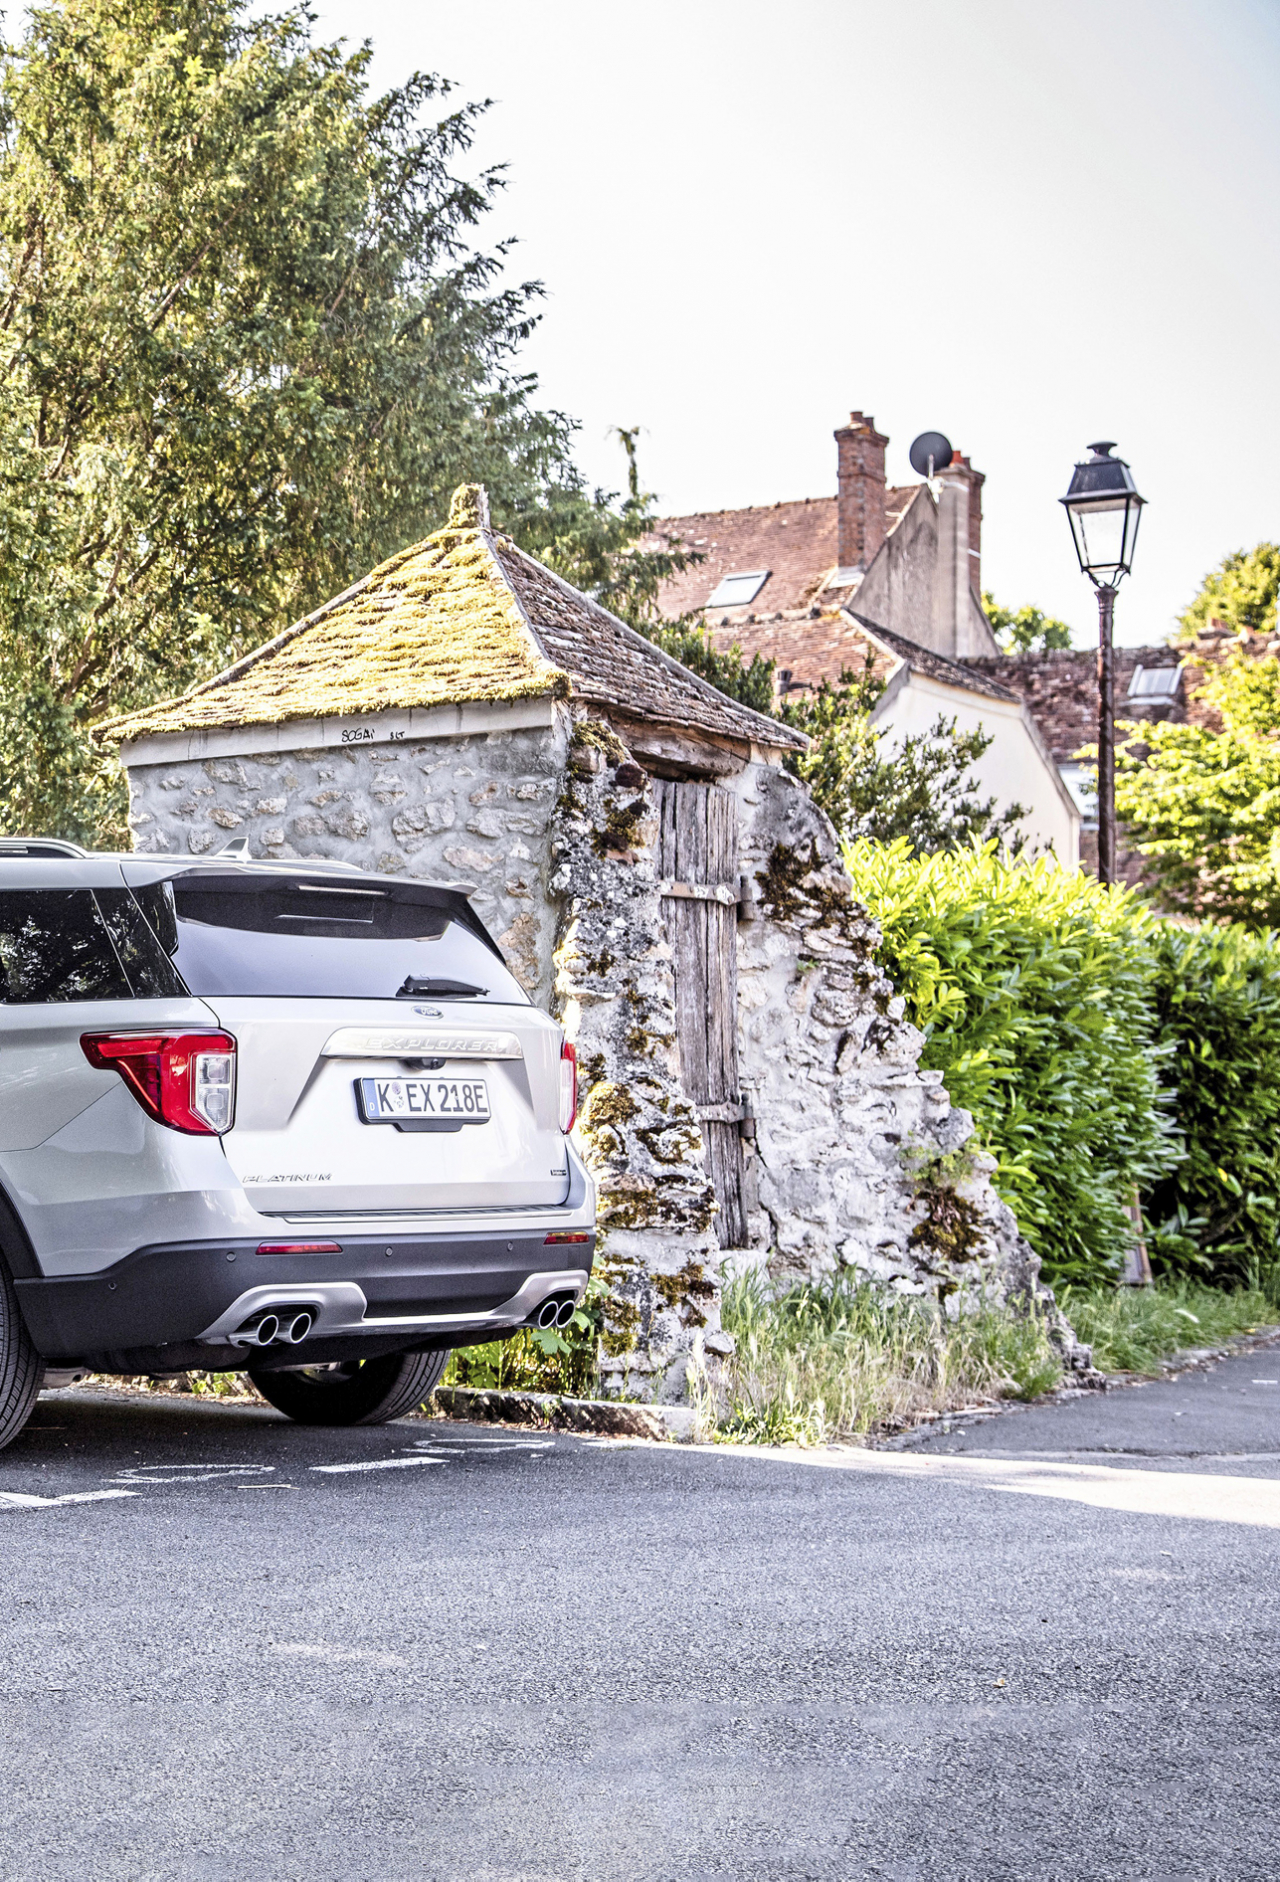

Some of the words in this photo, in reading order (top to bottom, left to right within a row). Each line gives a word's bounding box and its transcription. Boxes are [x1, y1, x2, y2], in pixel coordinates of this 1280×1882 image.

[365, 1037, 498, 1052] EXPLORER
[377, 1083, 394, 1112] K
[406, 1083, 436, 1112] EX
[437, 1083, 488, 1113] 218E
[369, 1102, 375, 1111] D
[242, 1173, 332, 1183] PLATINUM
